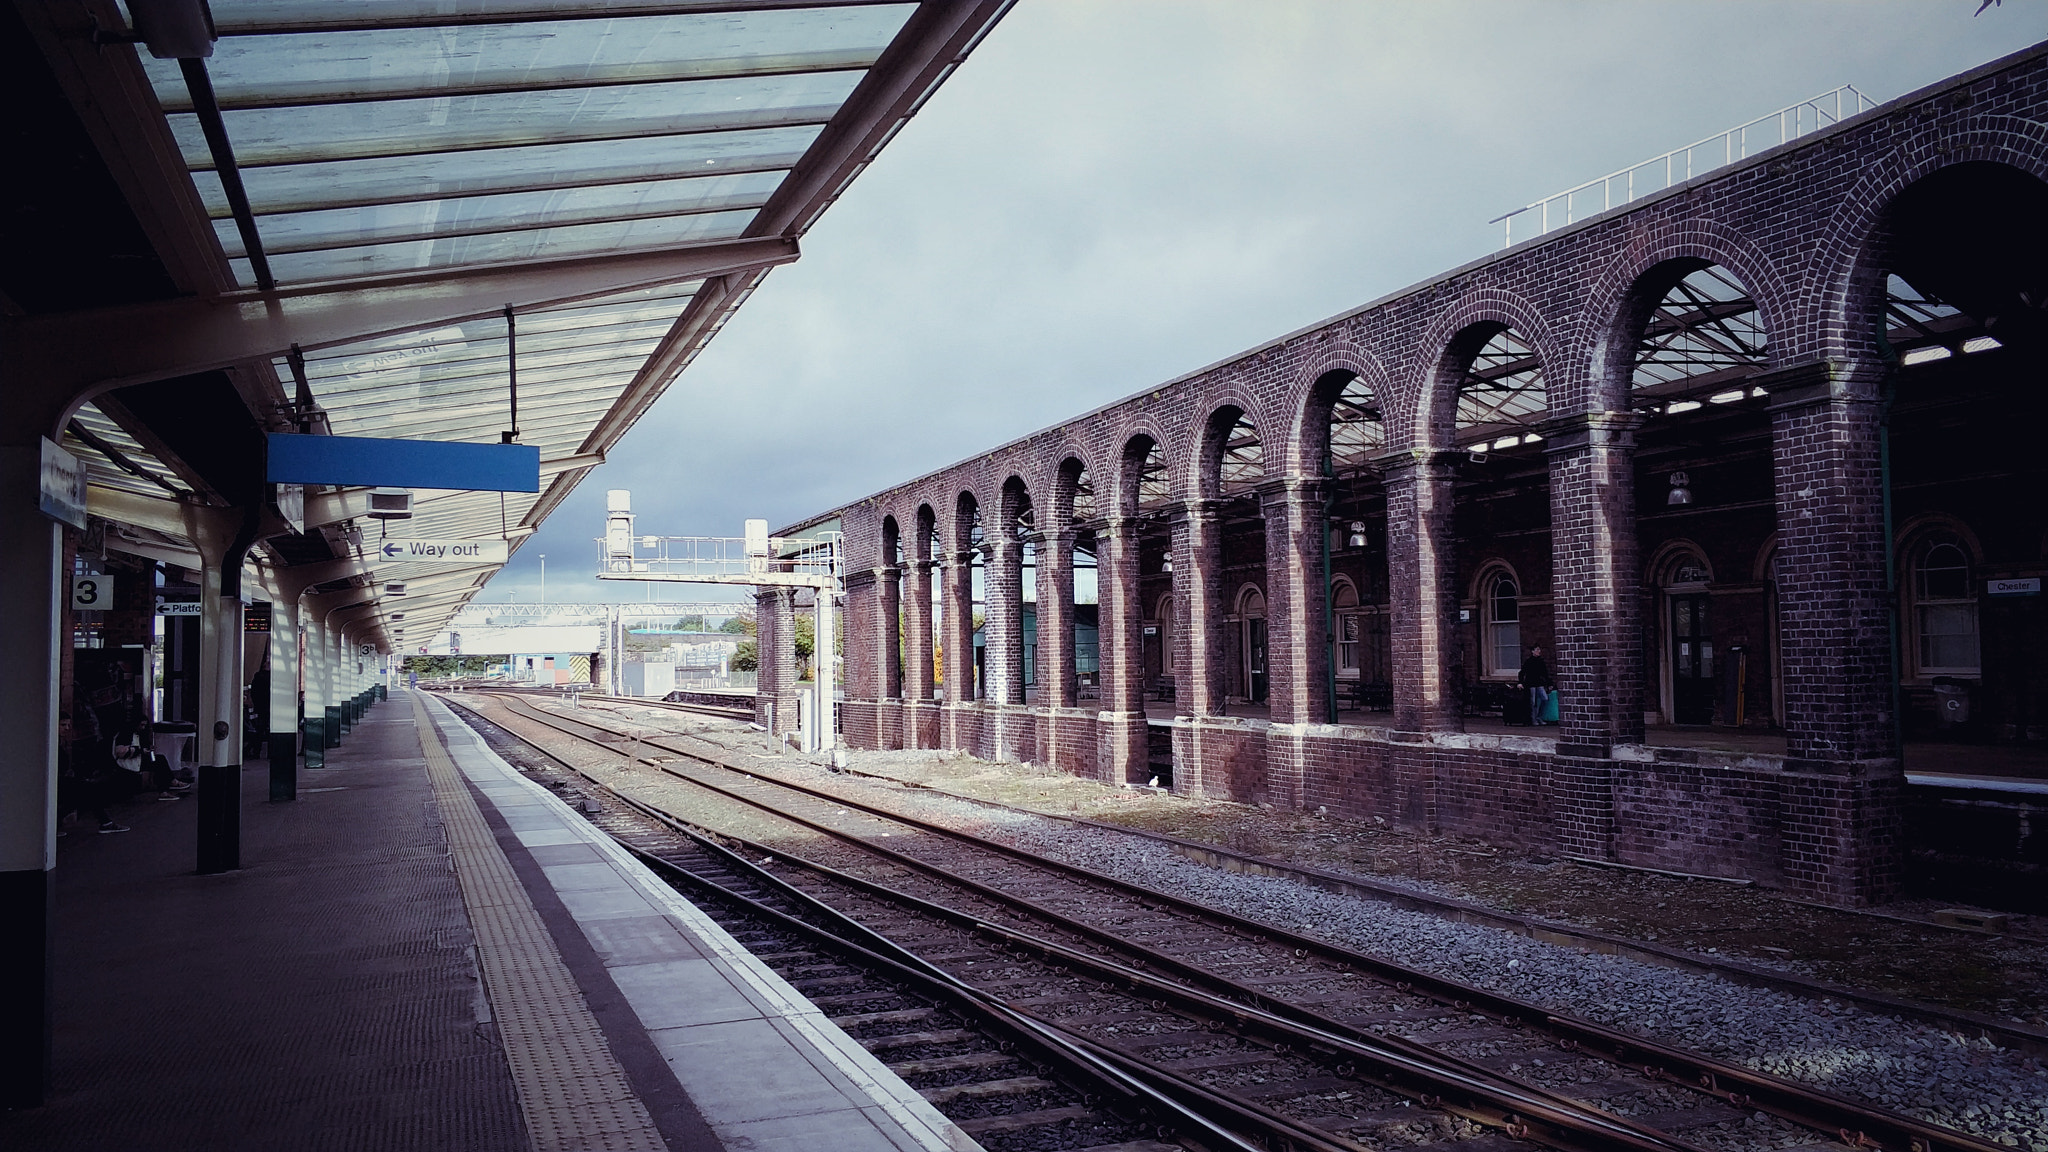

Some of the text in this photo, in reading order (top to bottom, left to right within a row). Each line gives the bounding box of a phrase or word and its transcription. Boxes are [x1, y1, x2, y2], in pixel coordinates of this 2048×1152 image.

[409, 542, 480, 558] Way out
[76, 580, 98, 604] 3
[1998, 582, 2030, 590] Chester
